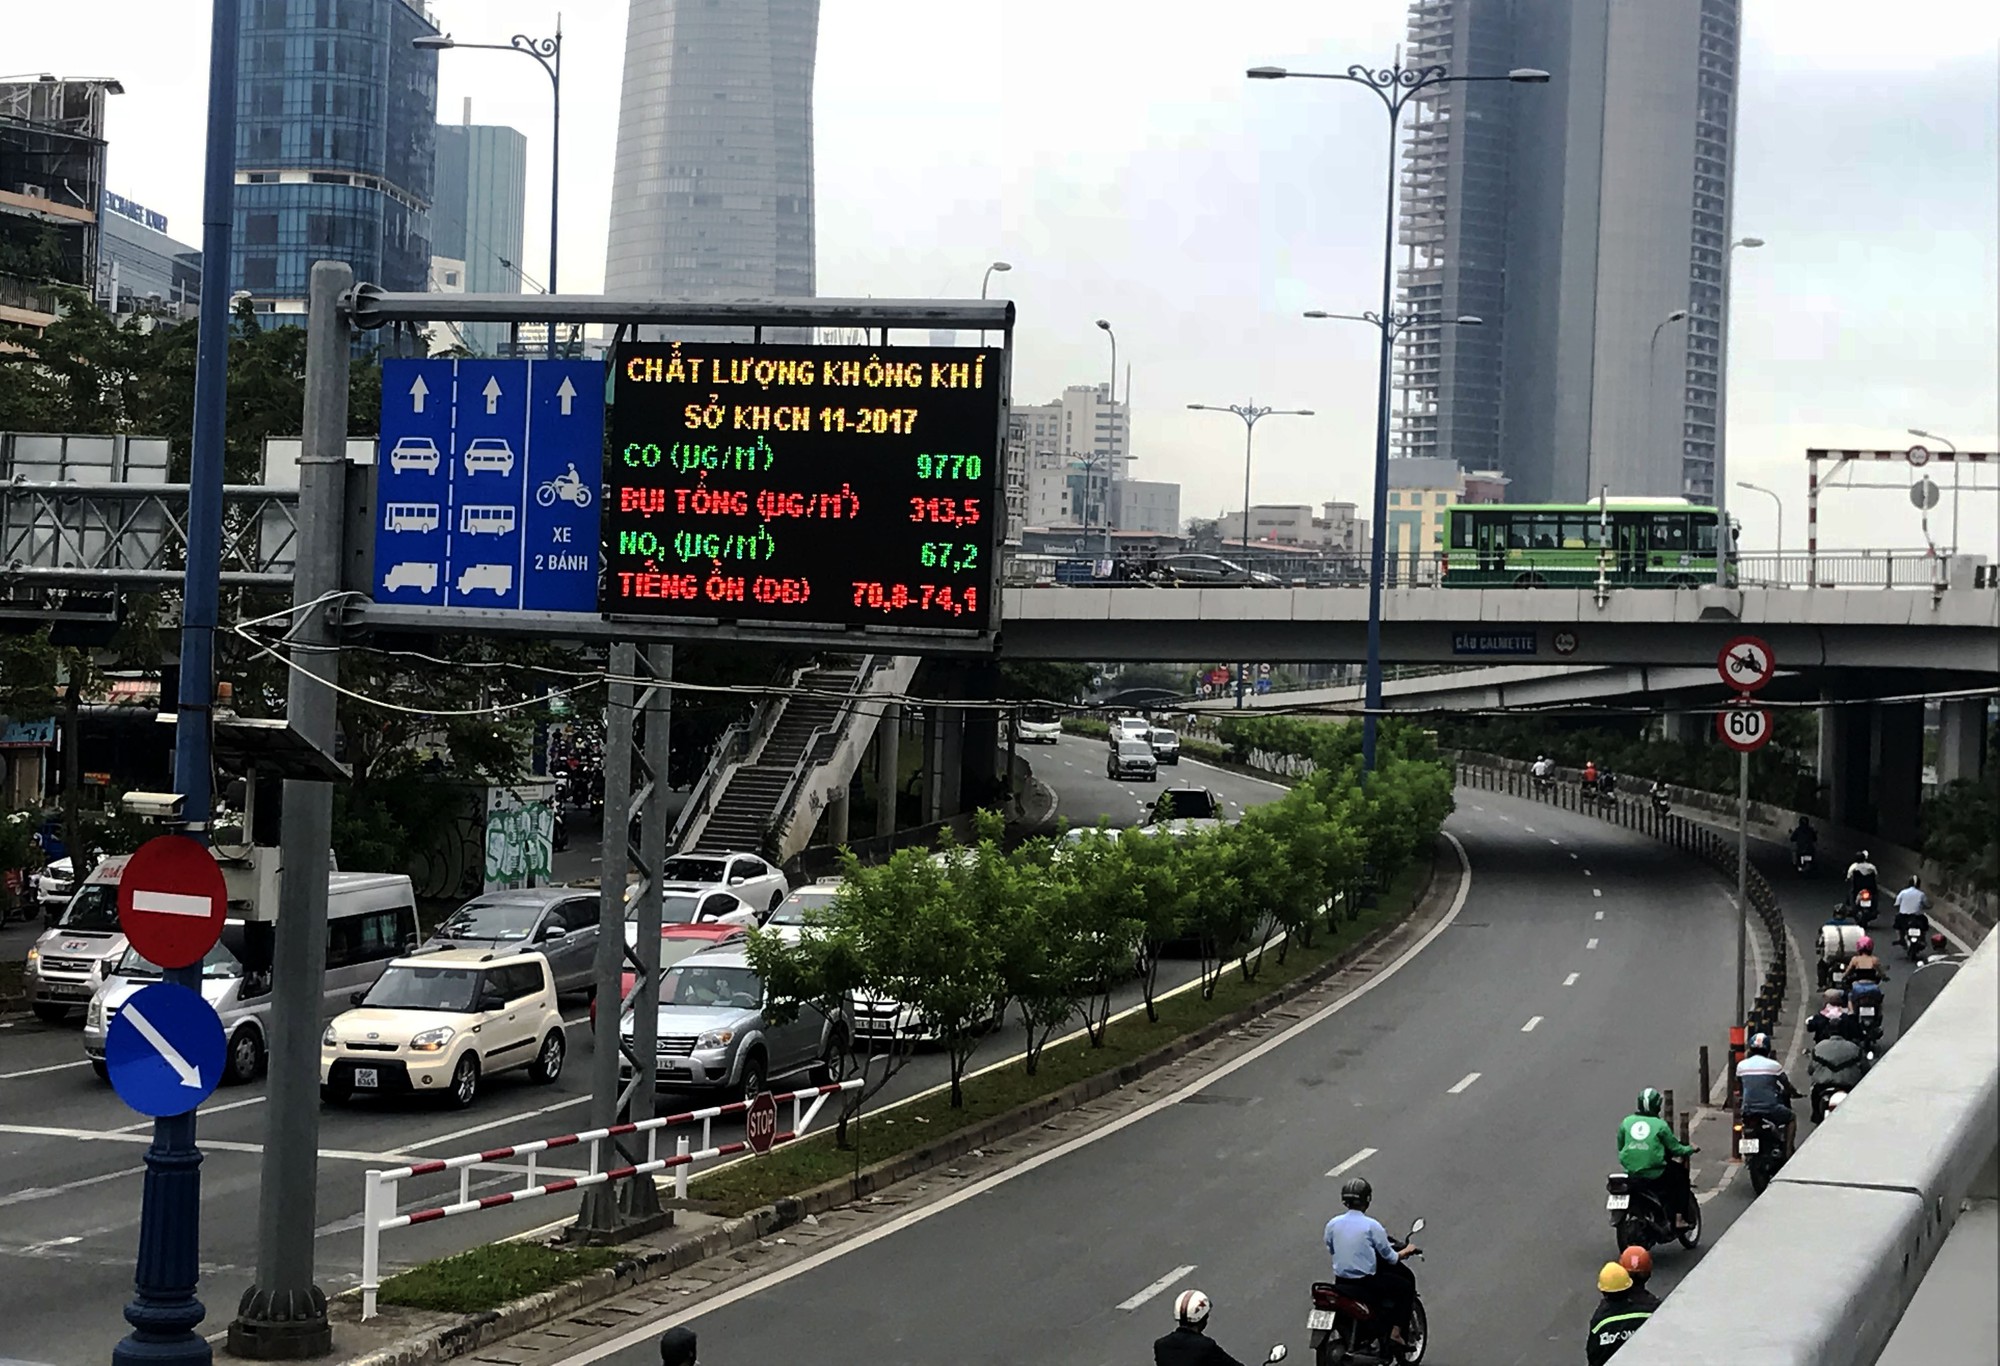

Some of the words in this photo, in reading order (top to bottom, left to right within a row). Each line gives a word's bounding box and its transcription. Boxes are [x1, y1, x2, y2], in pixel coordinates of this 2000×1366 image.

[713, 357, 815, 390] LƯỢNG
[823, 353, 922, 388] KHÔNG
[931, 355, 986, 389] KHÍ
[685, 394, 726, 429] SỞ
[734, 405, 810, 431] KHCN
[819, 407, 918, 434] 11-2017
[624, 443, 661, 468] CO
[917, 454, 981, 480] 9770
[621, 488, 665, 518] BỤI
[674, 470, 748, 516] TỔNG
[909, 498, 980, 528] 313,5
[553, 527, 571, 543] XE
[535, 554, 544, 570] 2
[548, 550, 588, 571] BÁNH
[921, 542, 978, 573] 67,2
[618, 560, 697, 599] TIẾNG
[706, 559, 744, 601] ỒN
[753, 575, 811, 603] (DB)
[852, 583, 977, 617] 70,8-74,1
[1730, 711, 1760, 736] 60
[750, 1109, 774, 1138] STOP
